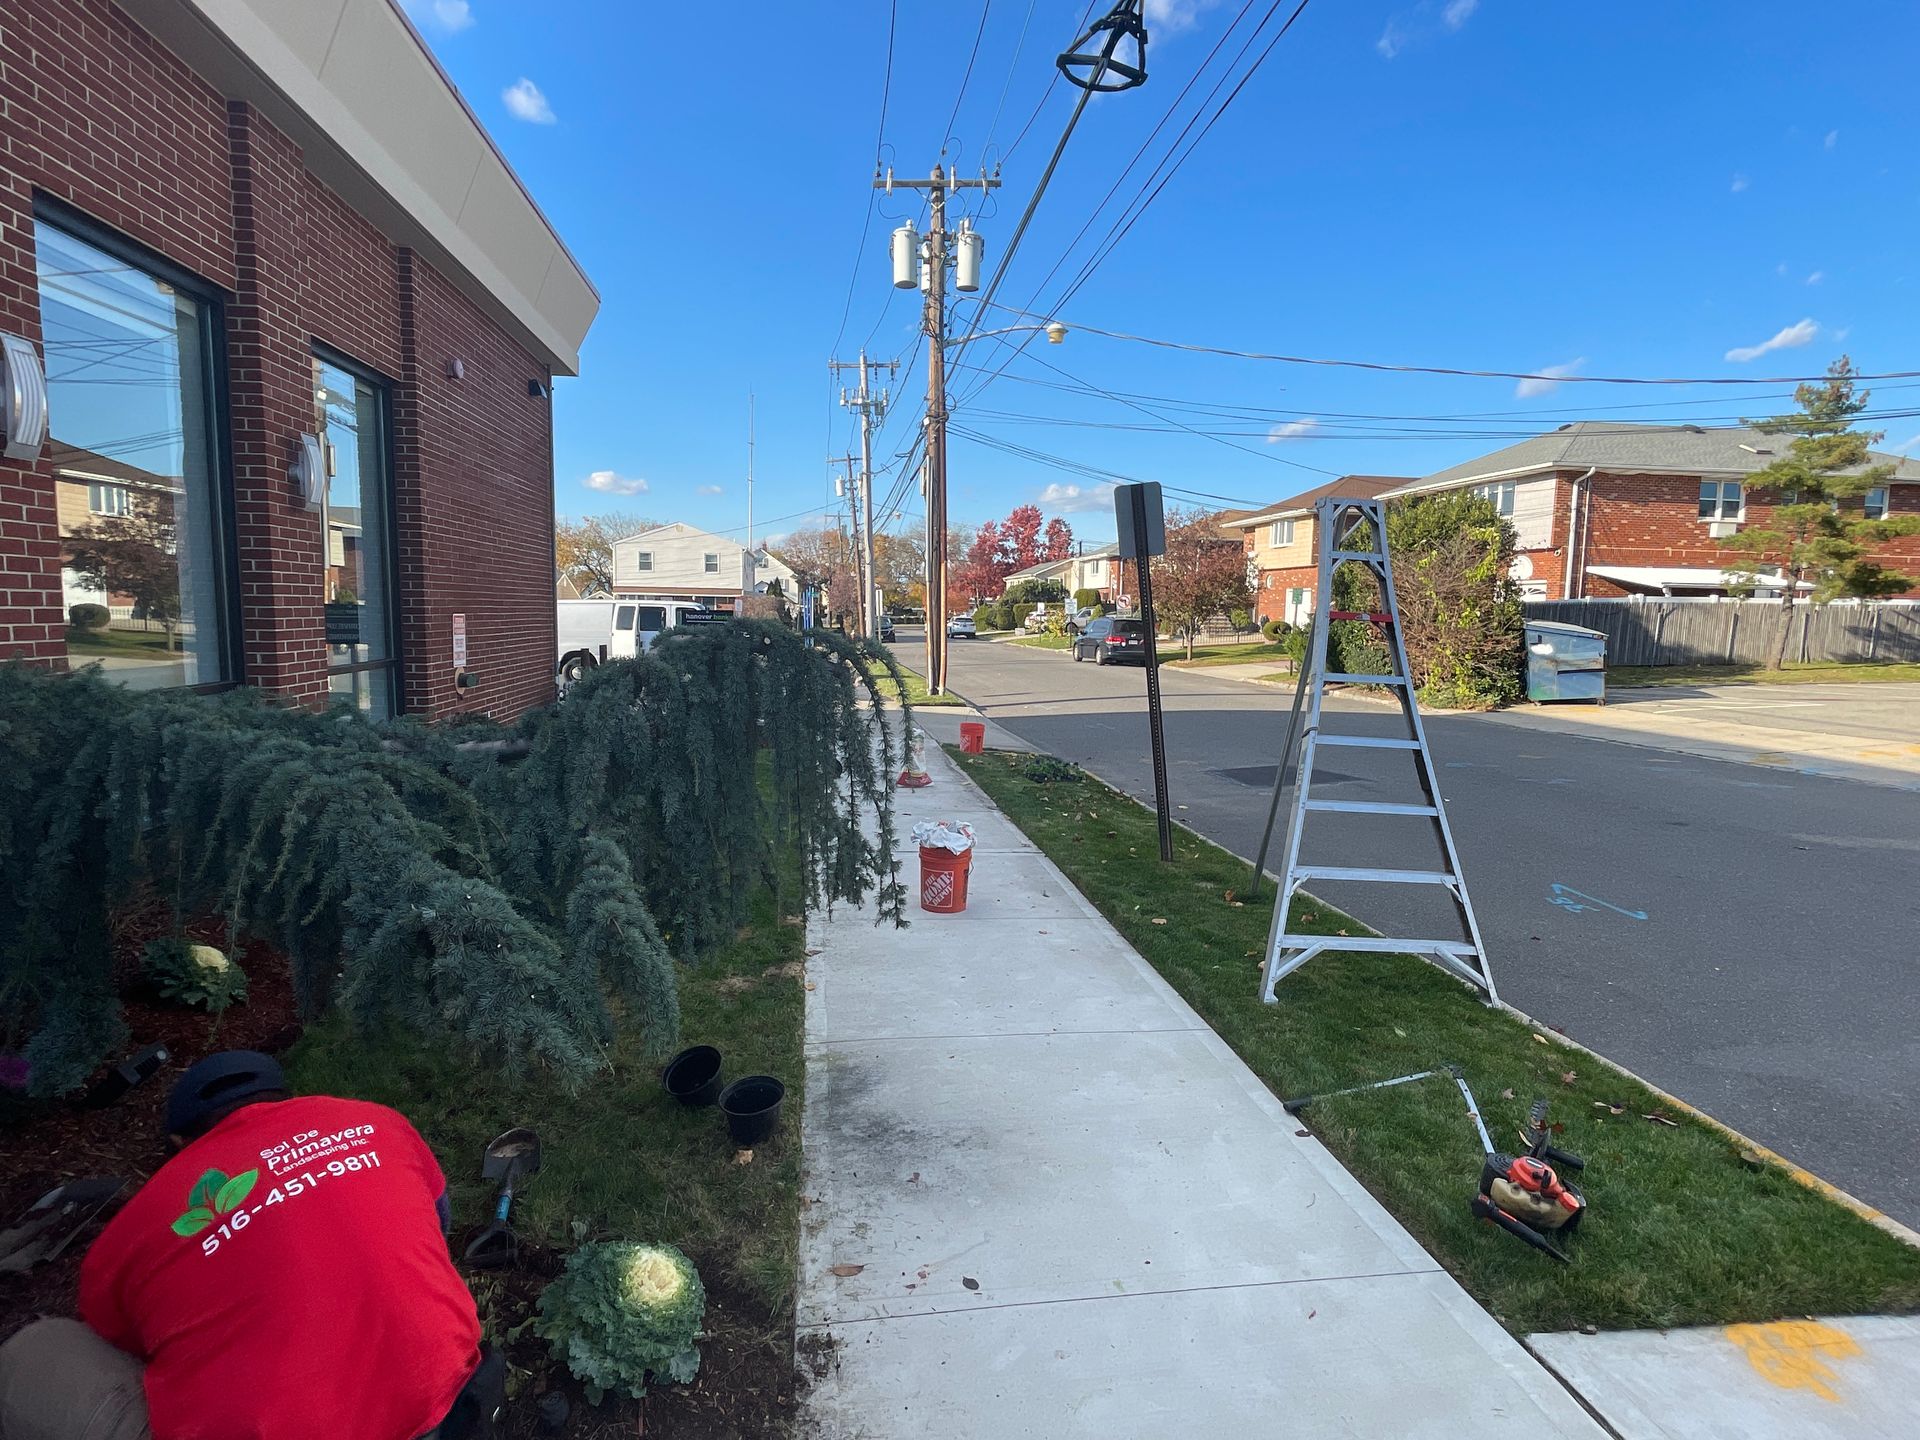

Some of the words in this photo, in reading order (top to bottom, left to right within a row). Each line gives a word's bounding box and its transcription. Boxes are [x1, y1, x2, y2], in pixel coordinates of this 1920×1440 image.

[260, 1141, 290, 1159] Sol
[292, 1129, 319, 1144] De
[267, 1124, 375, 1170] Primavera
[273, 1143, 349, 1176] Landscaping
[350, 1137, 369, 1148] Inc.
[202, 1151, 381, 1257] 516-451-9811
